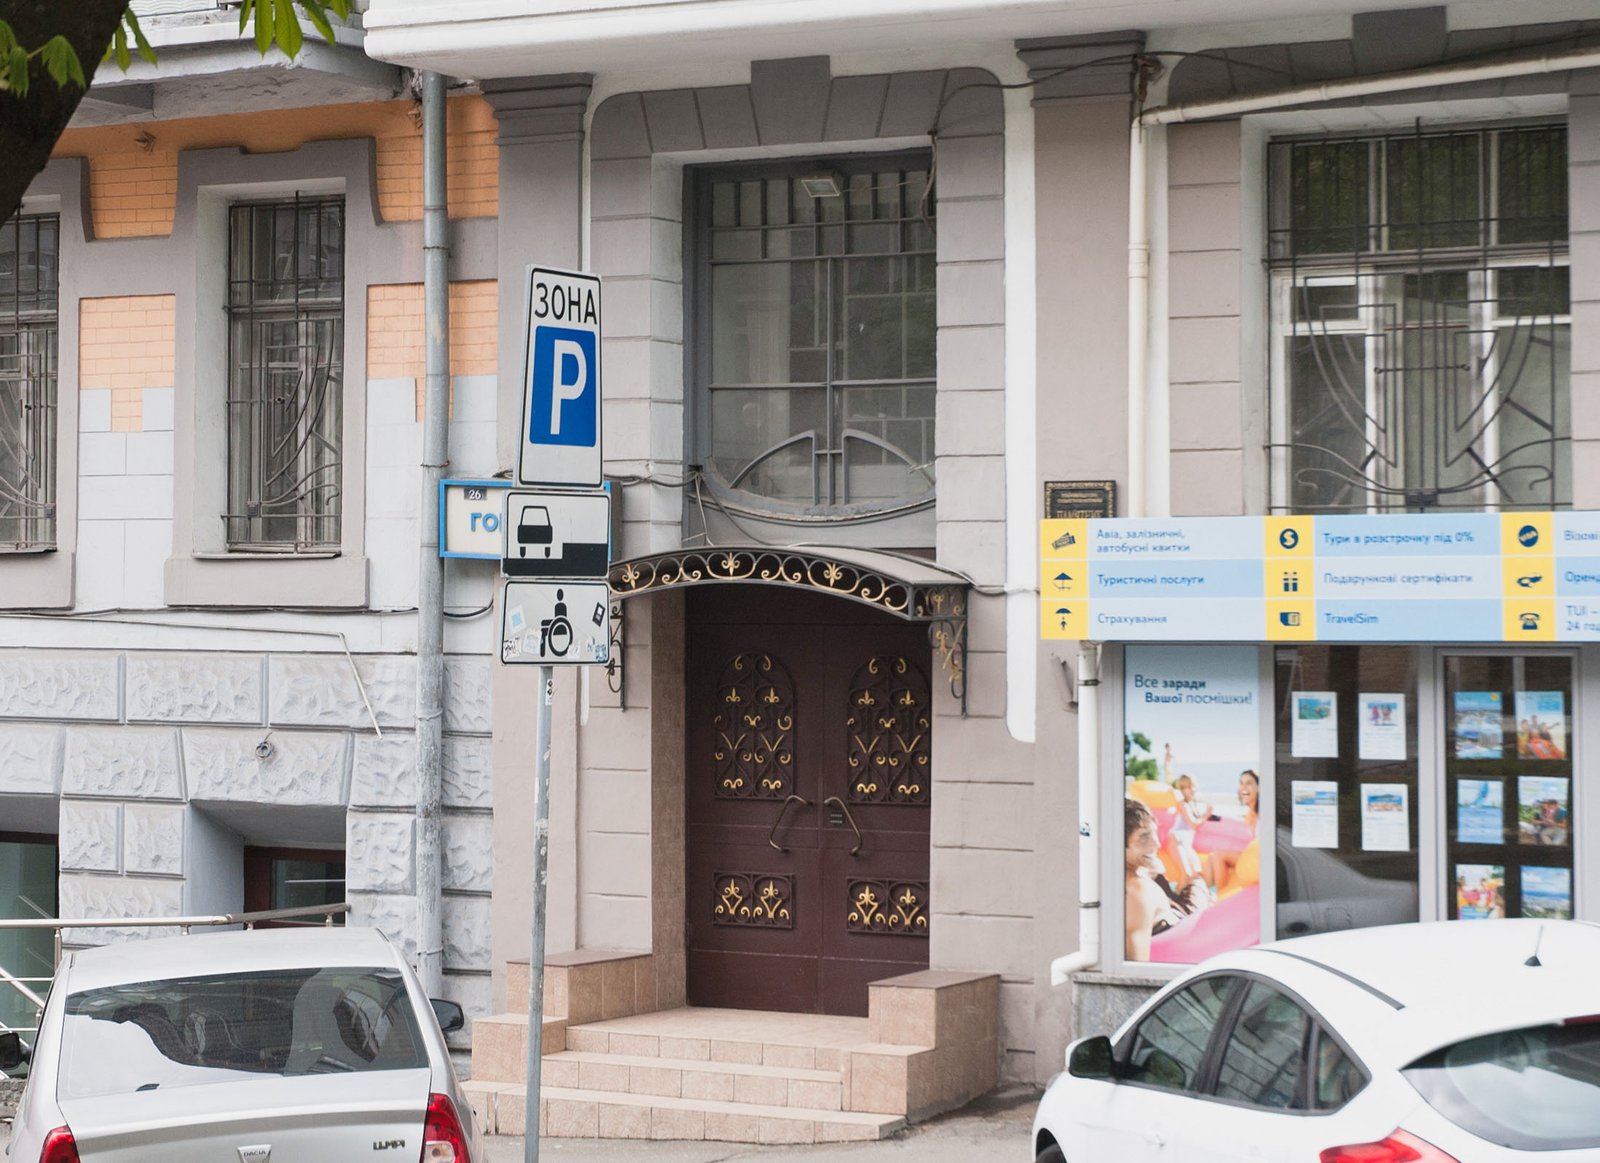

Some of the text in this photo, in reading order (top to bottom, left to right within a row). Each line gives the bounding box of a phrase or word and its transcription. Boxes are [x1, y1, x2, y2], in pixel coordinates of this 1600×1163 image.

[534, 282, 598, 325] ЗОНА
[550, 339, 587, 435] P
[468, 489, 481, 500] 26
[471, 512, 502, 533] ГО
[1097, 529, 1184, 540] Авіа, залізничні,
[1323, 532, 1350, 545] Тури
[1434, 533, 1452, 544] під
[1455, 531, 1474, 542] 0%
[1096, 543, 1190, 554] автобусні квитки
[1097, 574, 1205, 587] Туристичні послуги
[1324, 573, 1472, 585] Подарункові сертифікати
[1097, 613, 1167, 626] Страхування
[1324, 612, 1379, 623] TravelSim
[1134, 674, 1207, 691] Все заради
[1145, 692, 1252, 705] Вашої посмішки!
